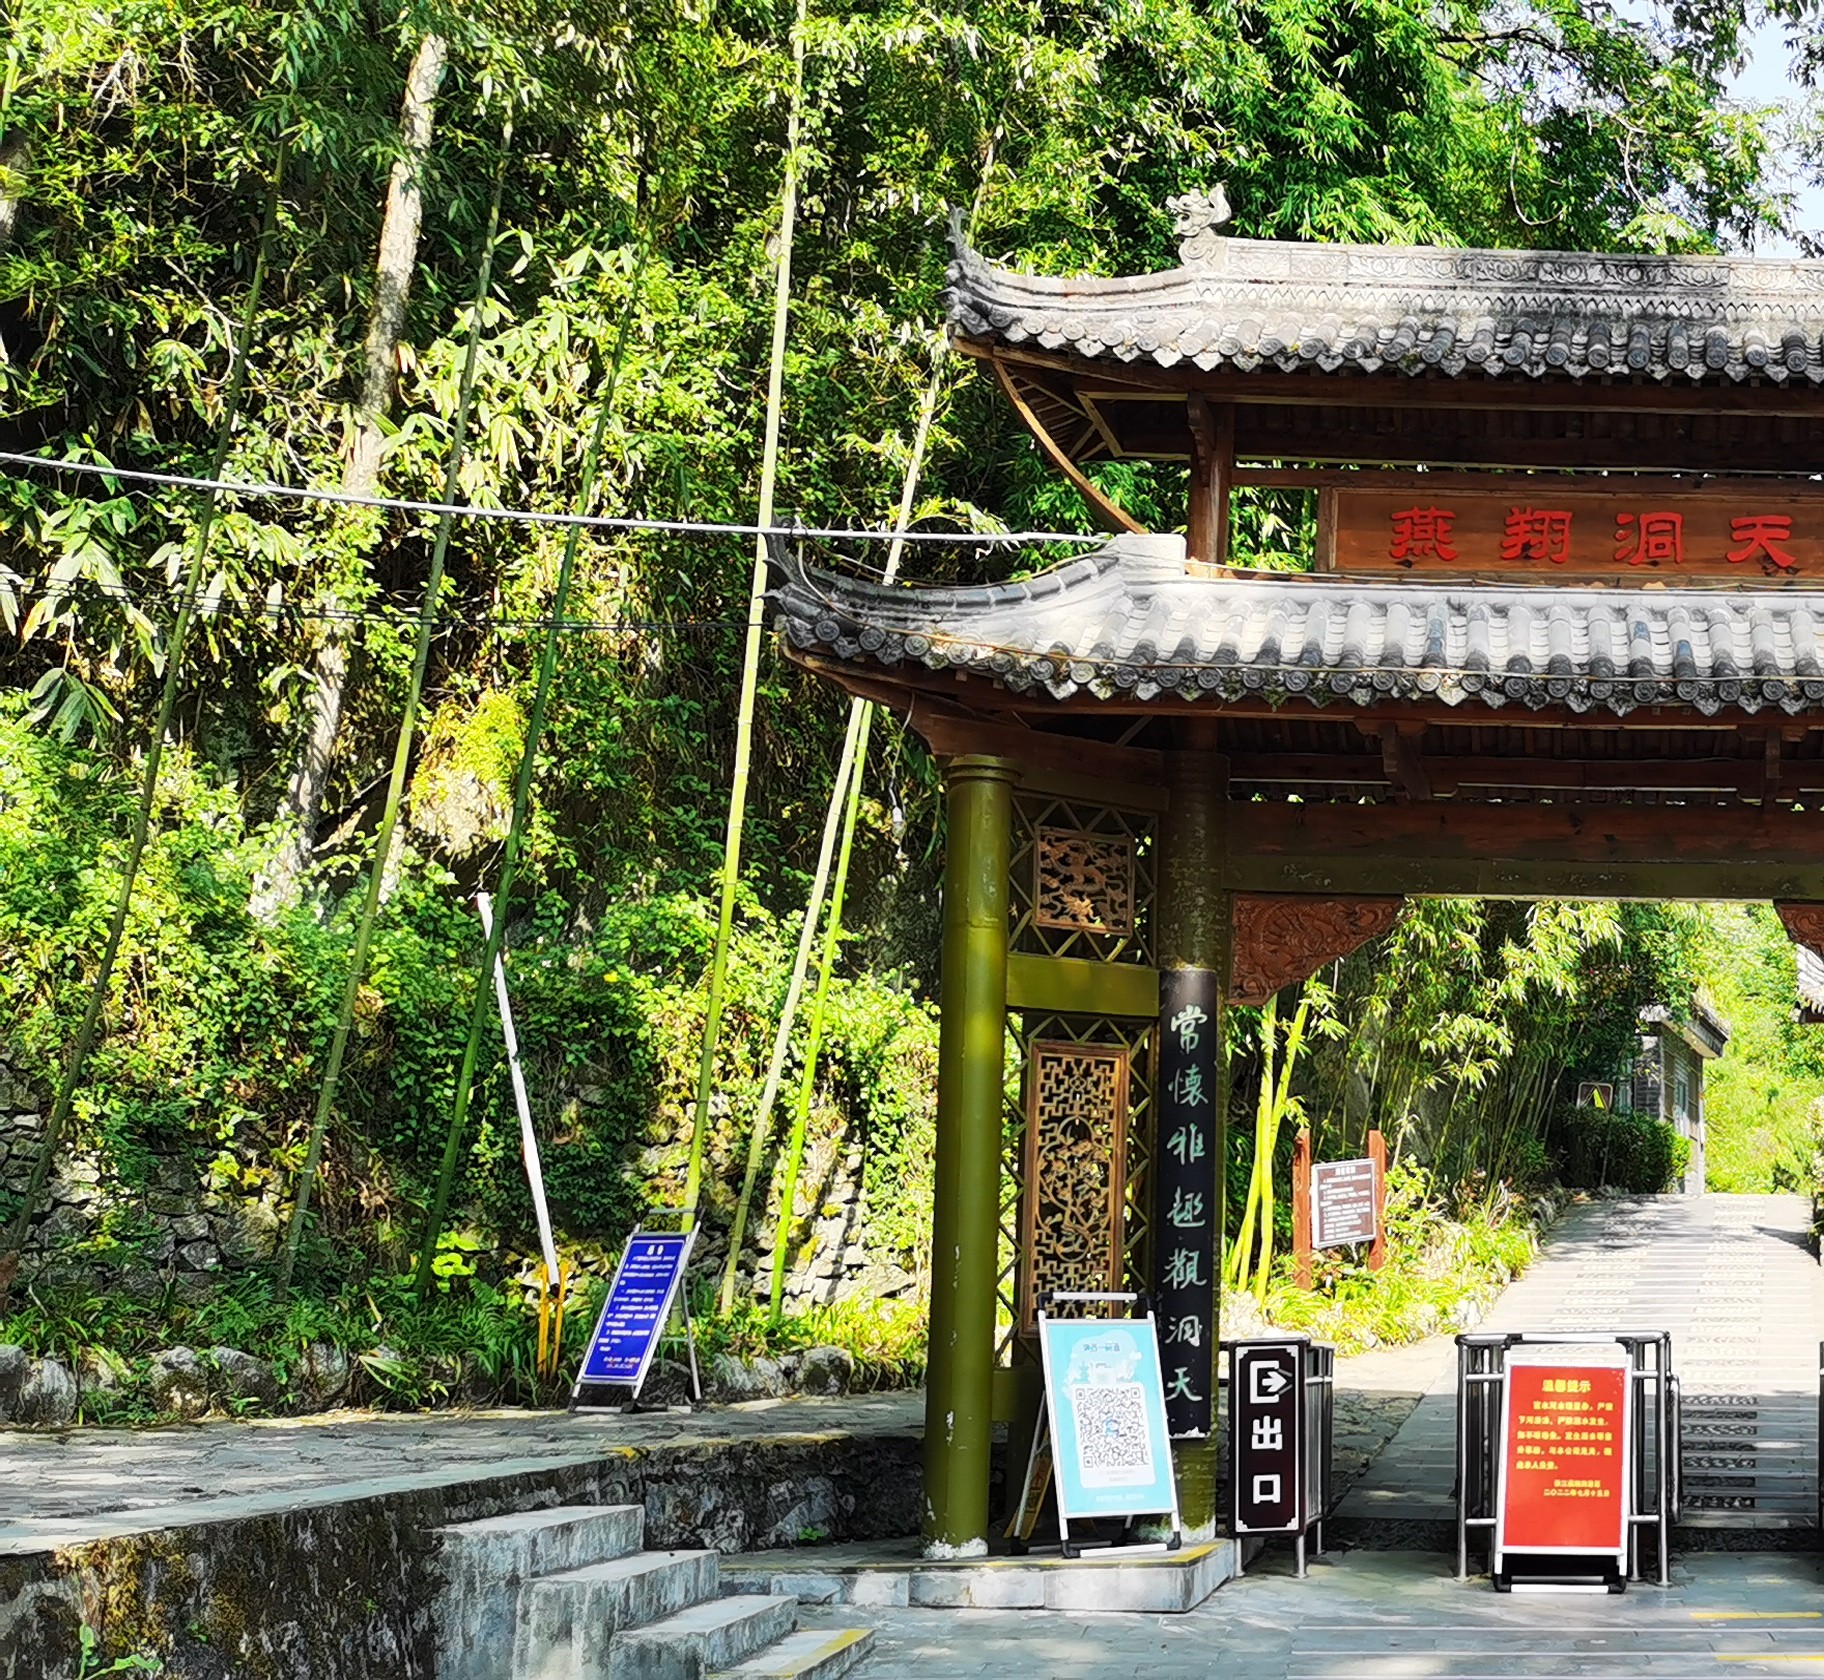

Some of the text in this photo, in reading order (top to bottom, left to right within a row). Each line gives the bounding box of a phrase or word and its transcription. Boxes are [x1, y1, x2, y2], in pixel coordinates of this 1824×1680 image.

[1389, 505, 1797, 568] 燕翔洞天
[1251, 1415, 1283, 1504] 出口
